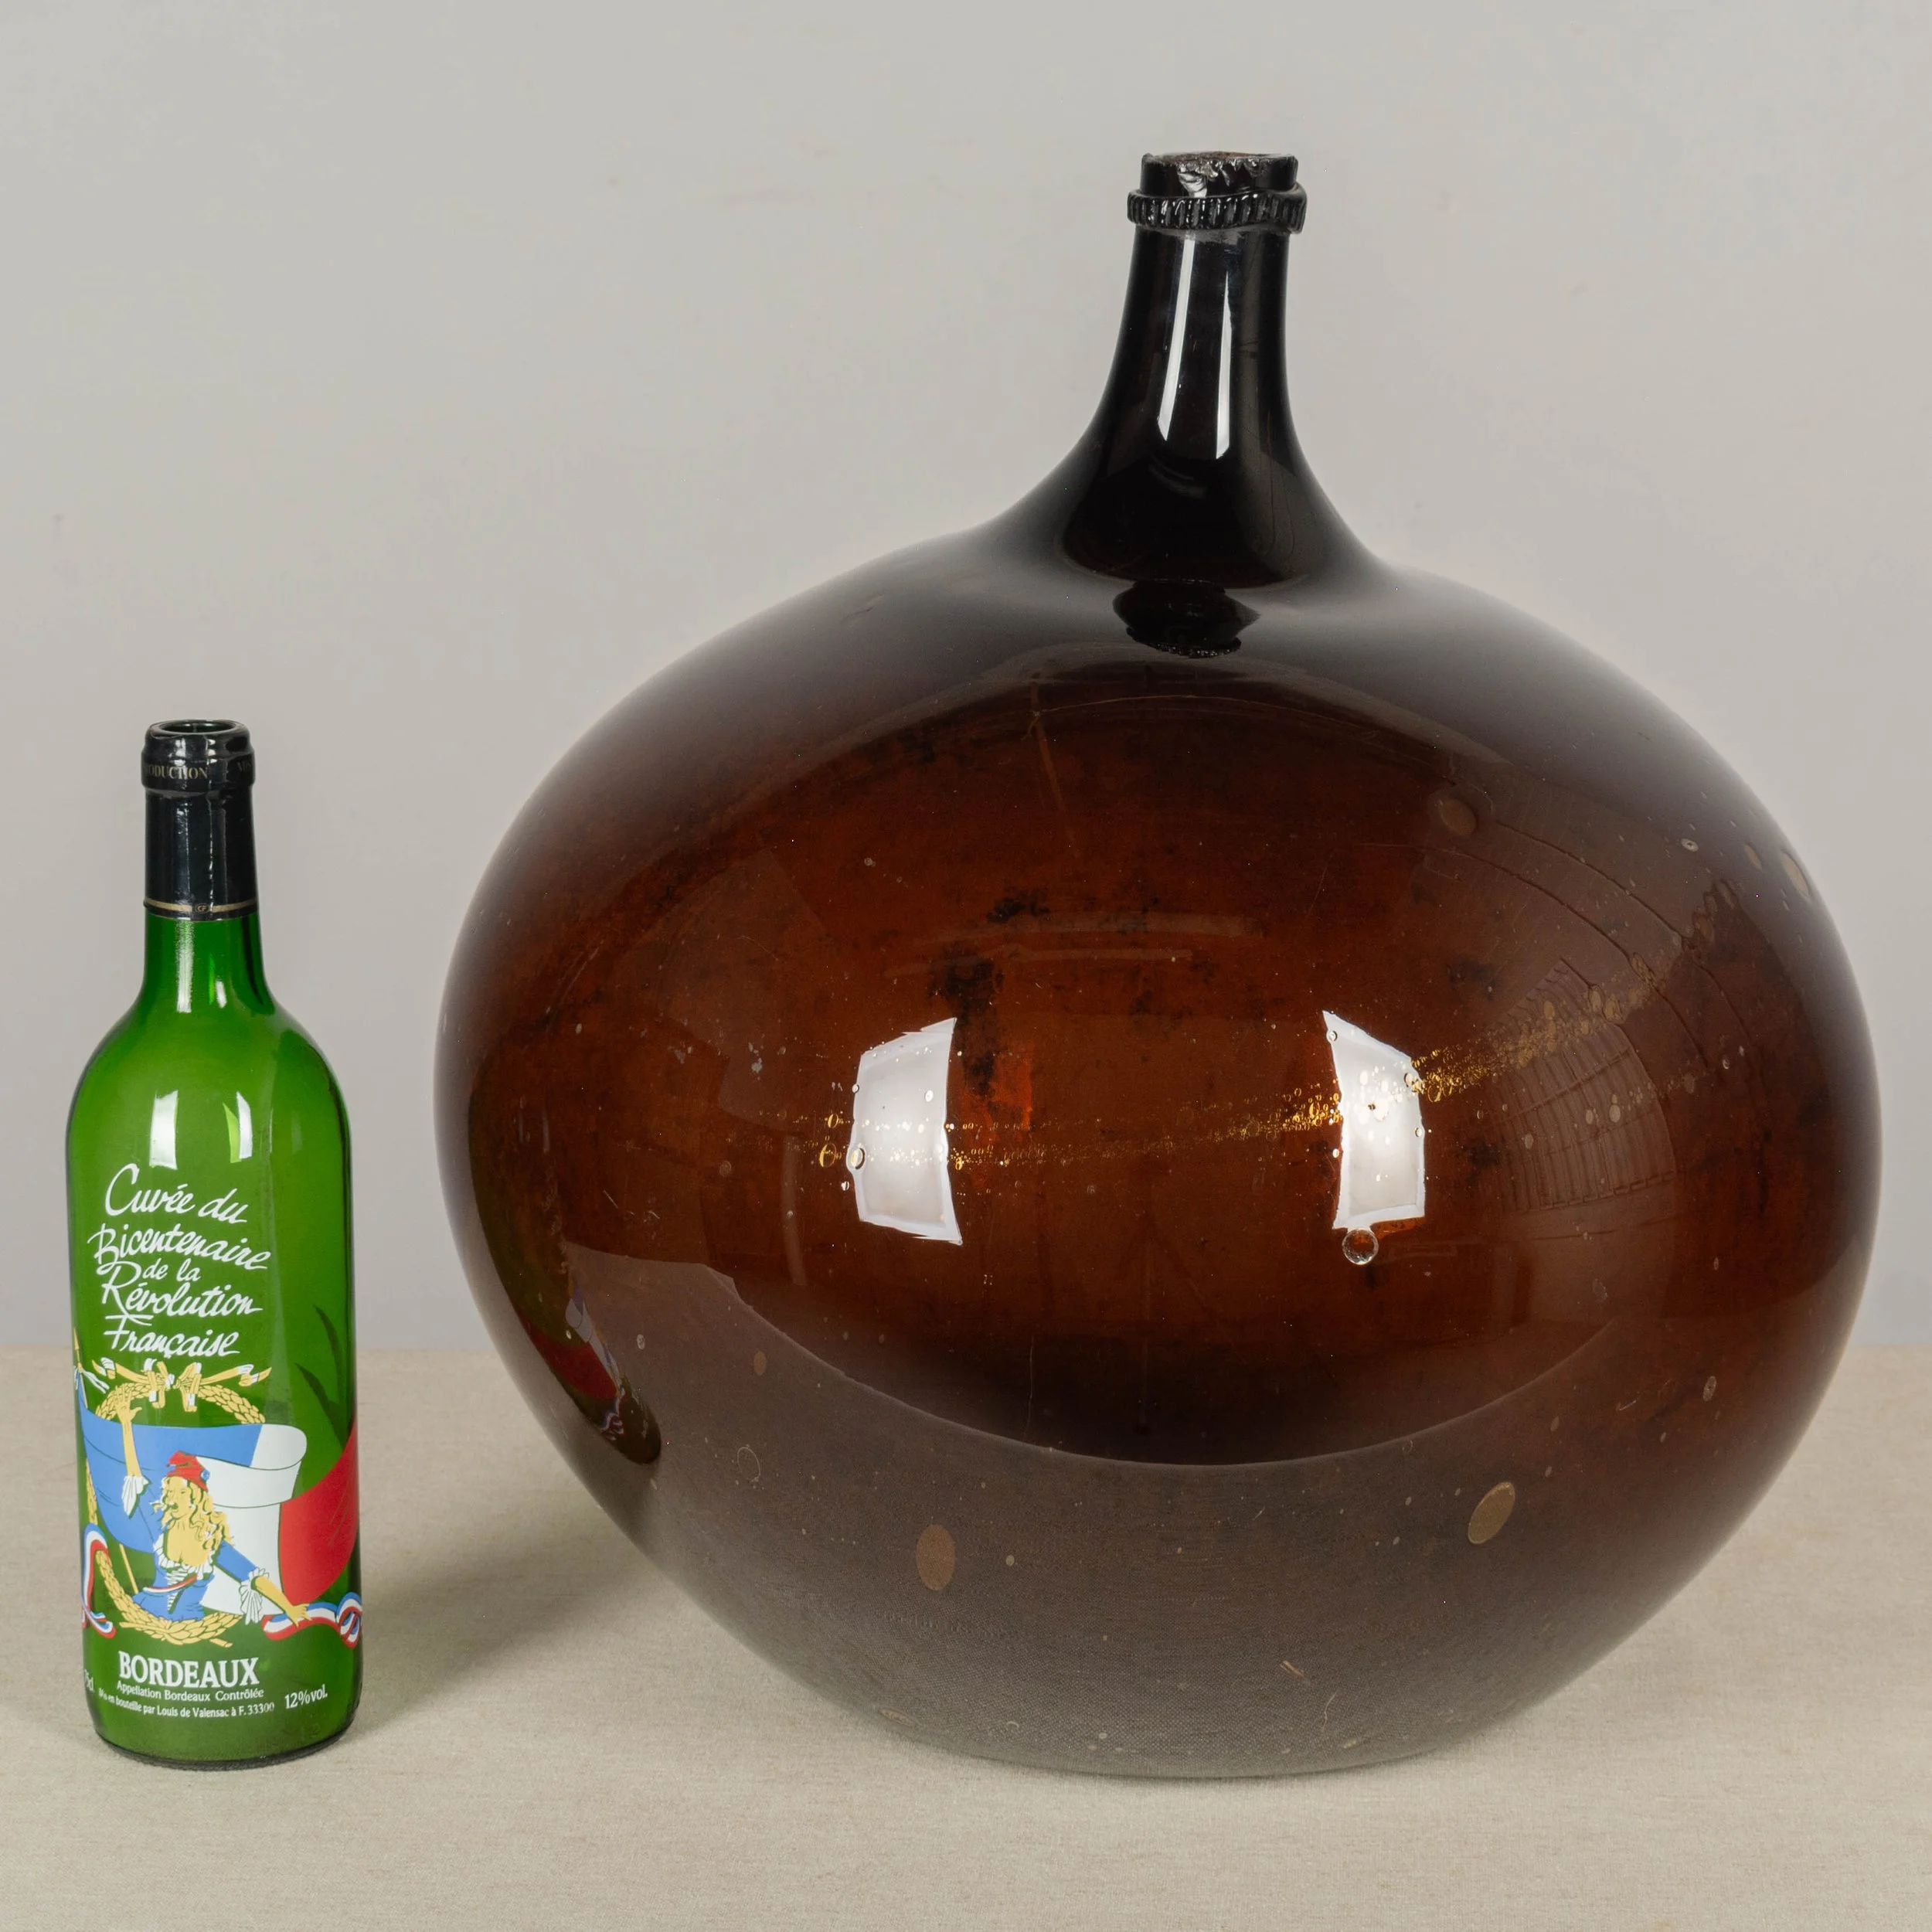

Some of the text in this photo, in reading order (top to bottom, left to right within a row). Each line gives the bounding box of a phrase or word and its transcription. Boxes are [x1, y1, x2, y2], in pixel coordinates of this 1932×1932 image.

[105, 1163, 249, 1224] Cuvée du
[87, 1223, 271, 1270] Bicentenaire
[142, 1258, 201, 1281] de la
[97, 1261, 264, 1325] Révolution
[104, 1314, 240, 1359] Française
[118, 1651, 260, 1689] BORDEAUX
[117, 1681, 264, 1702] Appellation Bordeaux Contrôlée
[143, 1705, 156, 1716] par
[157, 1705, 179, 1717] Louis
[180, 1707, 191, 1718] de
[192, 1707, 230, 1719] Valensac
[230, 1705, 237, 1716] à
